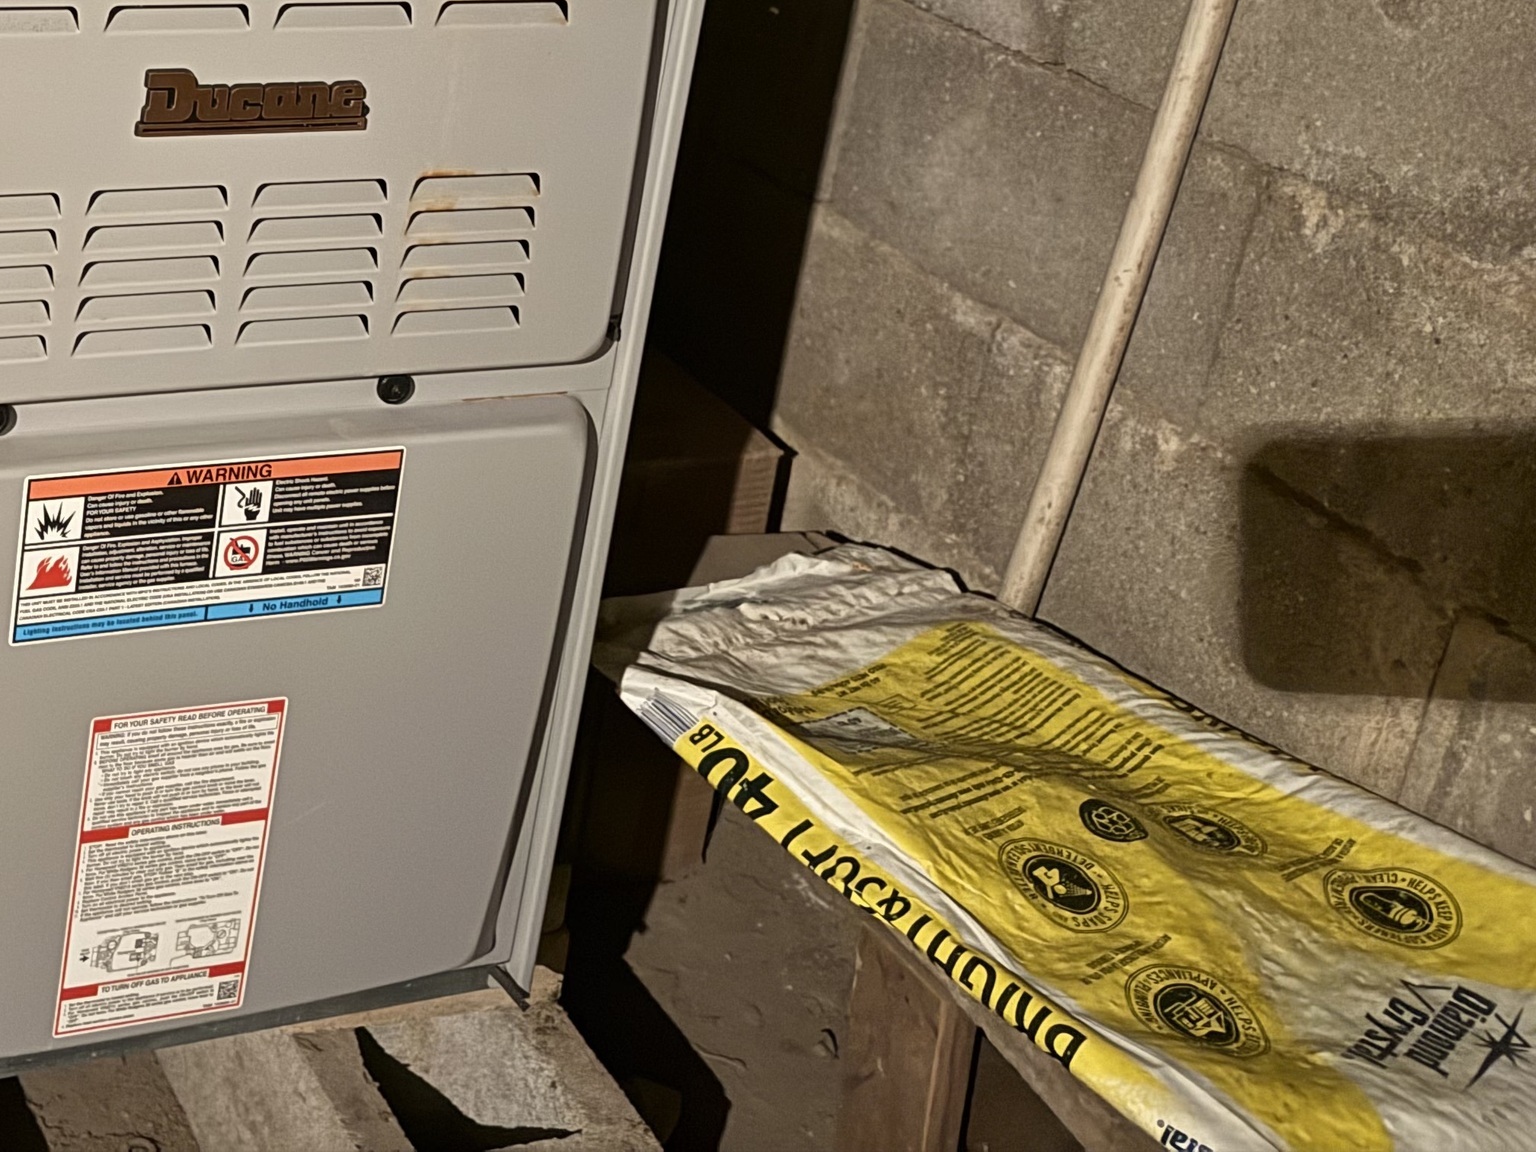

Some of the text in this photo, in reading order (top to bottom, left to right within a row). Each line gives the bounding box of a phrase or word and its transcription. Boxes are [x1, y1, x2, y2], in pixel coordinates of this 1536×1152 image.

[144, 68, 366, 122] Ducane
[186, 464, 272, 483] WARNING
[262, 596, 328, 611] No Handhold
[113, 705, 265, 729] FOR YOUR SAFETY READ BEFORE OPERATING
[688, 724, 725, 752] LB
[130, 817, 220, 836] OPERATING INSTRUCTIONS
[1406, 878, 1442, 902] HELPS
[1072, 910, 1112, 928] SOAPS
[101, 985, 110, 993] TO
[111, 982, 129, 991] TURN
[130, 980, 144, 989] OFF
[144, 977, 159, 986] GAS
[160, 976, 169, 984] TO
[170, 970, 207, 982] APPLIANCE
[1146, 968, 1217, 990] APPLIANCES
[1224, 996, 1256, 1032] HELPS
[1401, 985, 1496, 1078] Diamond
